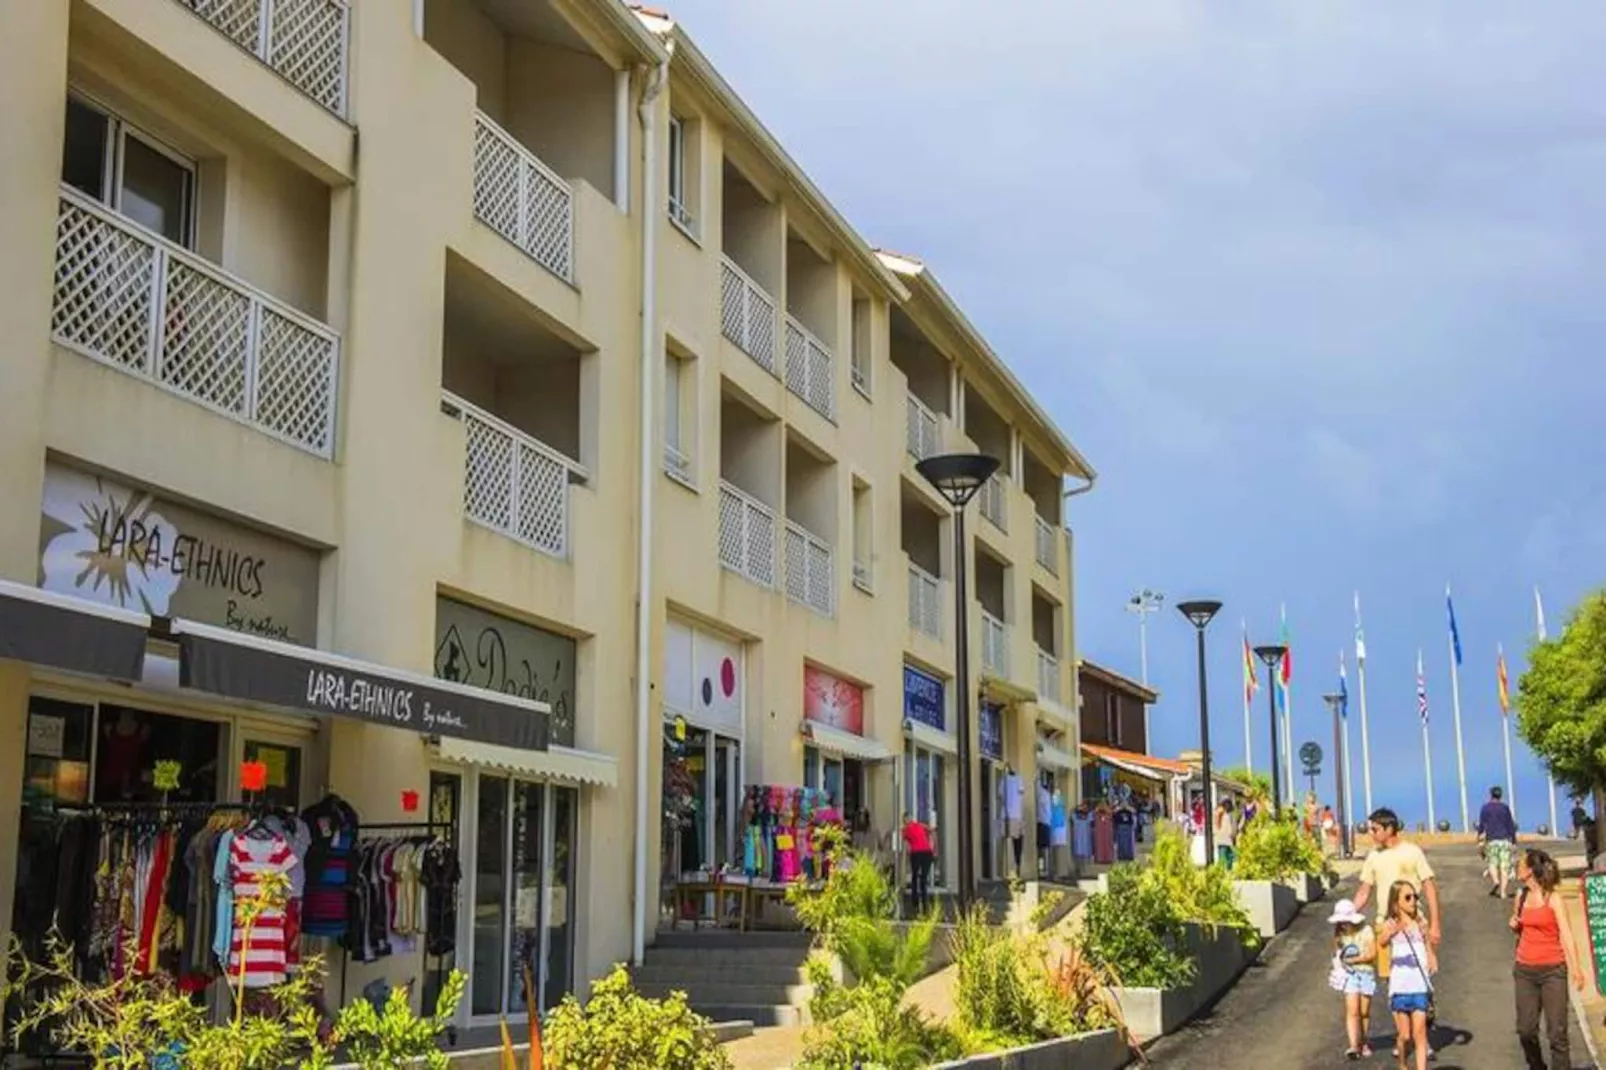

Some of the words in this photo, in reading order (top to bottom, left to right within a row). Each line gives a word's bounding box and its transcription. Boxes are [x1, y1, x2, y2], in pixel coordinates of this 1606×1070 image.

[98, 511, 265, 598] LARA-ETHNICS
[226, 600, 244, 631] By
[306, 669, 412, 722] LARA-ETHNICS
[423, 702, 436, 728] By
